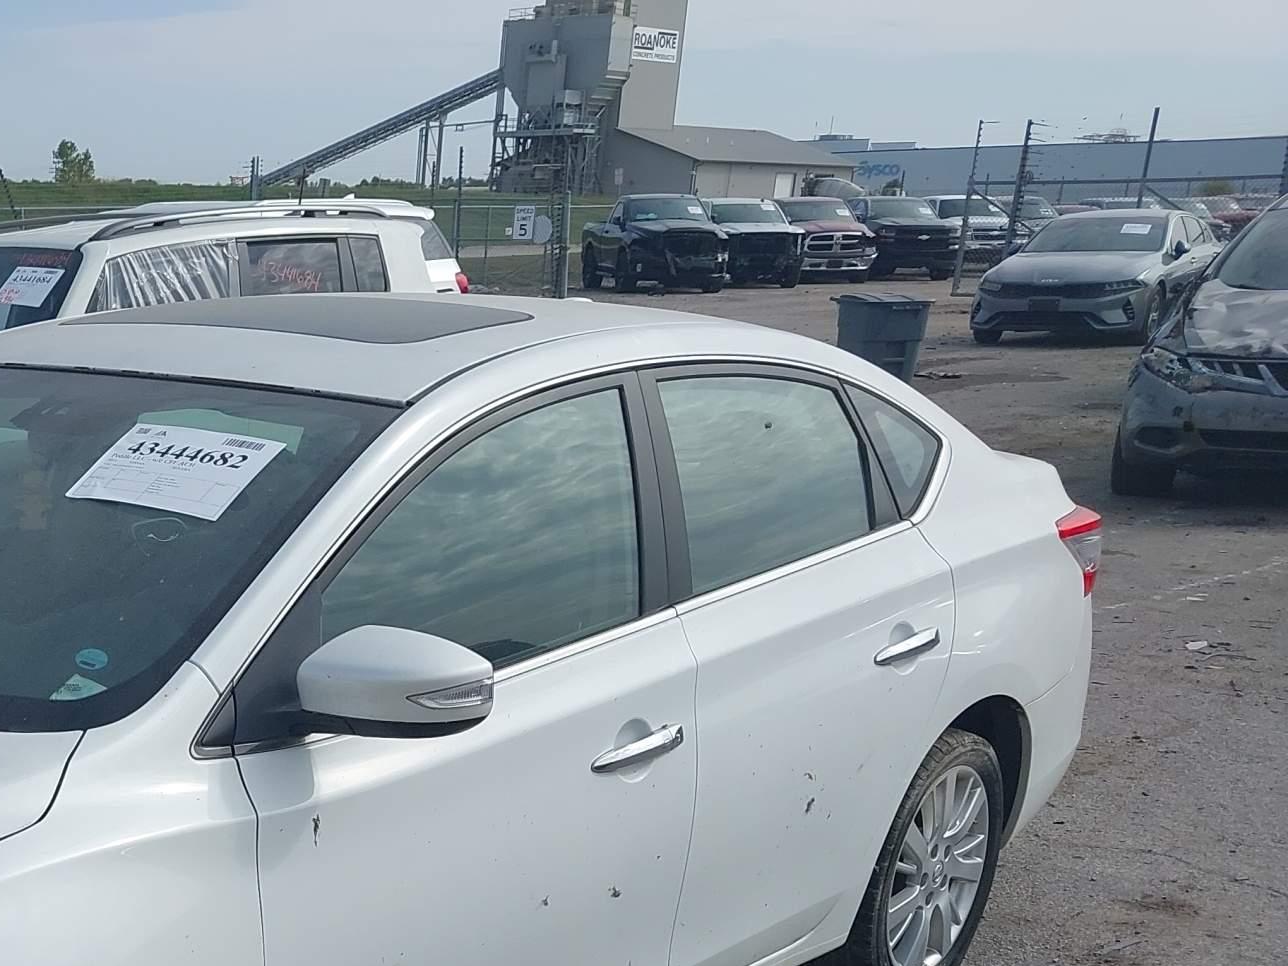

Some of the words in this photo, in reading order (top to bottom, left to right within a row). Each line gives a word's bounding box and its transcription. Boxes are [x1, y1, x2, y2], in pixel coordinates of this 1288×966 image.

[634, 32, 678, 49] ROANOKE
[518, 224, 527, 236] 5
[127, 440, 249, 469] 43444682
